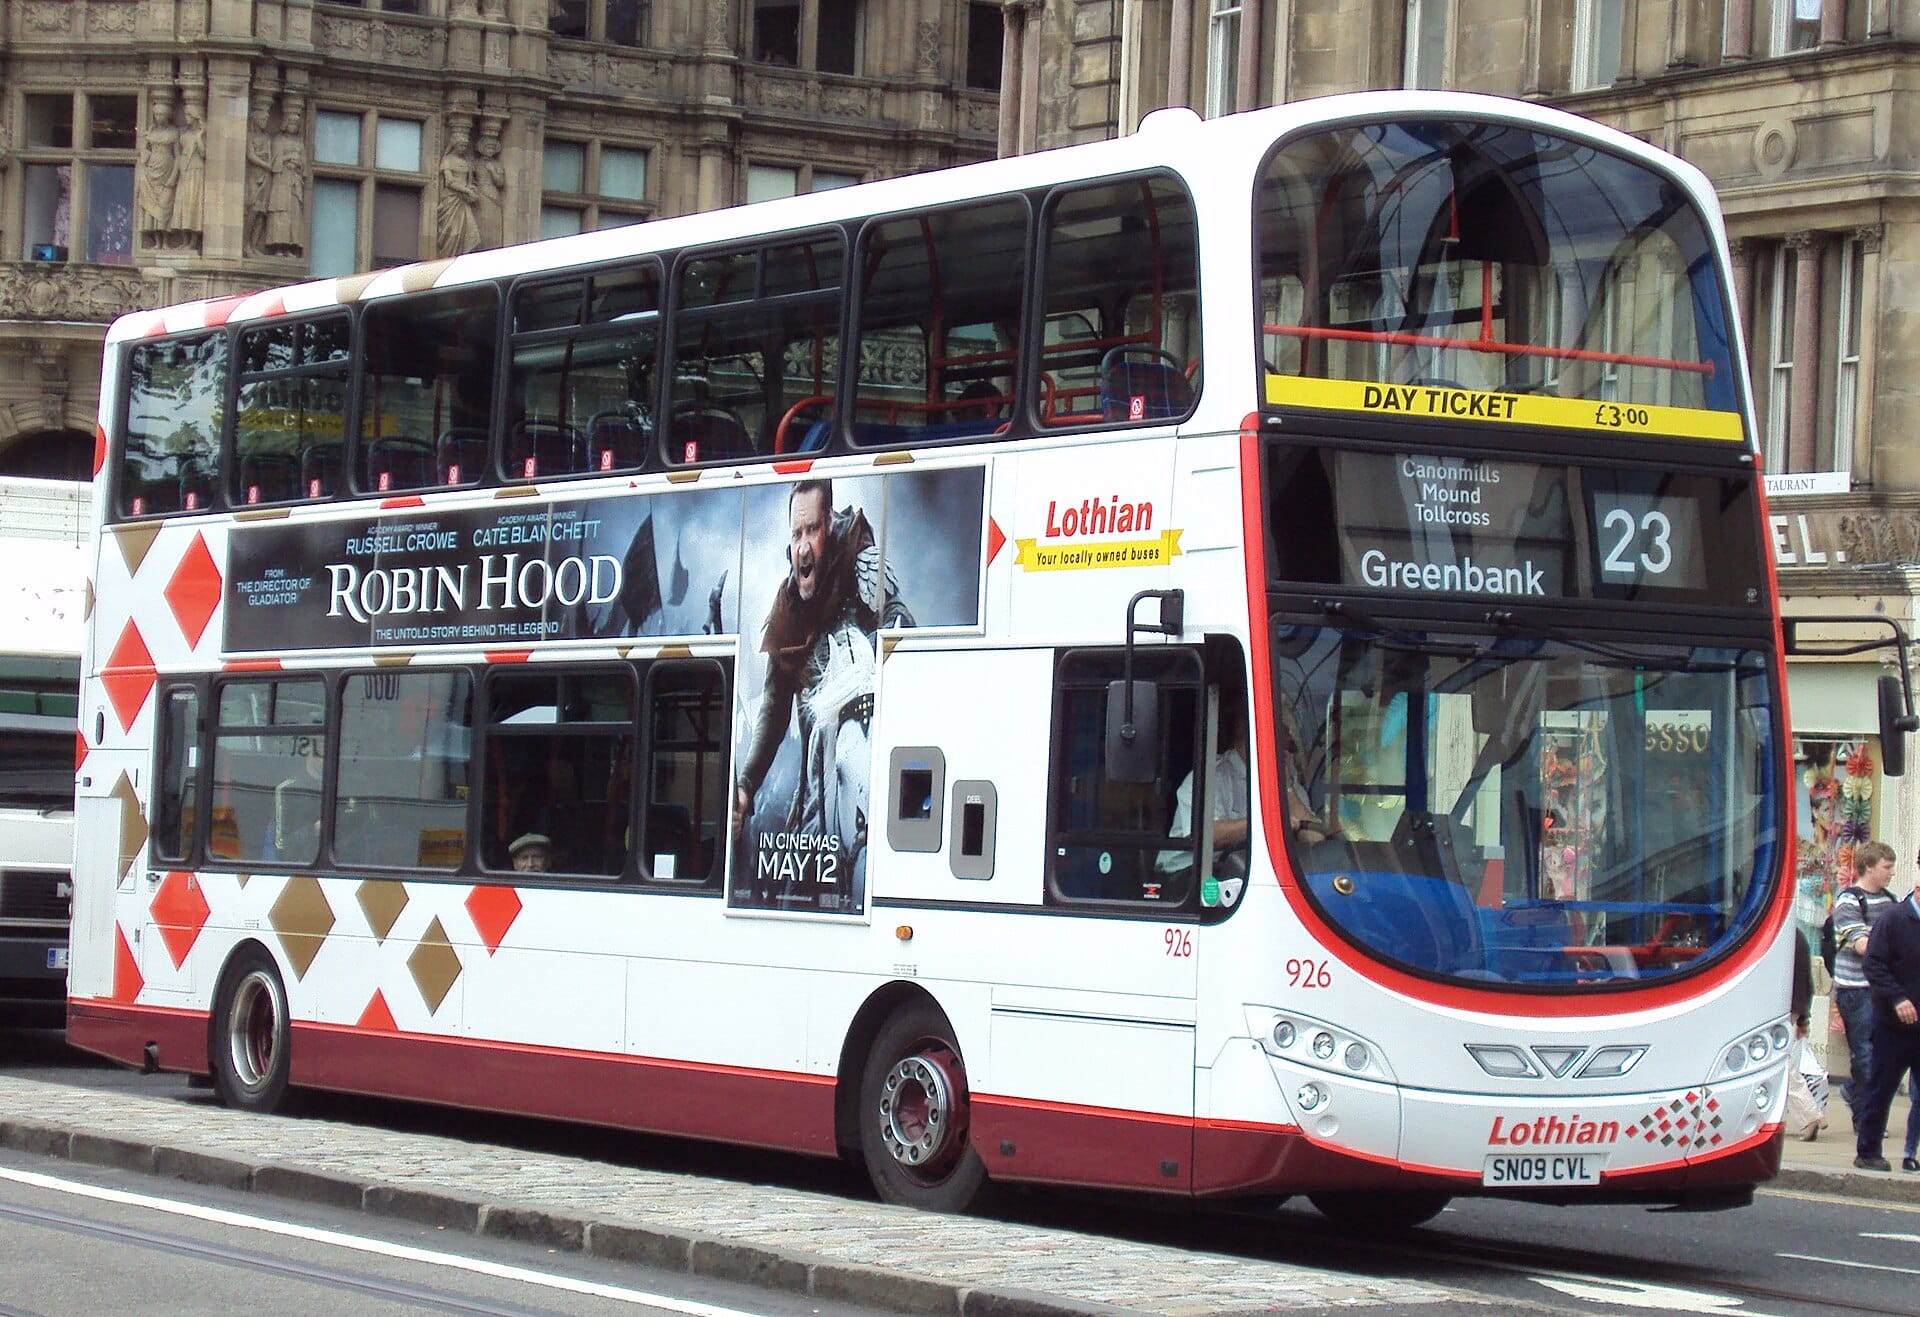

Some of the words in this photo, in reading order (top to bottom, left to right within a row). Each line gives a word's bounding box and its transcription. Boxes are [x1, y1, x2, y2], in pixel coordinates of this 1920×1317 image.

[1363, 386, 1418, 411] DAY
[1425, 390, 1518, 419] TICKET
[1402, 458, 1500, 484] Canonmills
[1422, 483, 1481, 504] Mound
[1045, 494, 1154, 537] Lothian
[1414, 503, 1490, 526] Tollcross
[346, 536, 404, 555] RUSSELL
[406, 531, 458, 552] CROWE
[472, 526, 509, 547] CATE
[510, 520, 601, 544] BLANCHETT
[1603, 508, 1672, 574] 23
[1036, 552, 1057, 566] Your
[1060, 549, 1092, 567] locally
[1096, 547, 1128, 562] owned
[1131, 547, 1160, 560] buses
[236, 581, 253, 593] THE
[254, 578, 298, 592] DIRECTOR
[298, 578, 311, 589] OF
[264, 568, 284, 578] FROM
[1360, 549, 1546, 596] Greenbank
[248, 592, 296, 606] GLADIATOR
[325, 563, 469, 624] ROBIN
[476, 553, 623, 611] HOOD
[376, 629, 393, 640] THE
[393, 627, 430, 639] UNTOLD
[431, 626, 461, 638] STORY
[462, 624, 496, 637] BEHIND
[498, 623, 517, 636] THE
[517, 621, 559, 635] LEGEND
[759, 832, 773, 849] IN
[775, 832, 840, 852] CINEMAS
[757, 851, 811, 881] MAY
[814, 853, 838, 884] 12
[1165, 928, 1192, 957] 926
[1285, 958, 1332, 989] 926
[1488, 1113, 1620, 1146] Lothian
[1493, 1158, 1547, 1182] SN09
[1552, 1156, 1592, 1180] CVL
